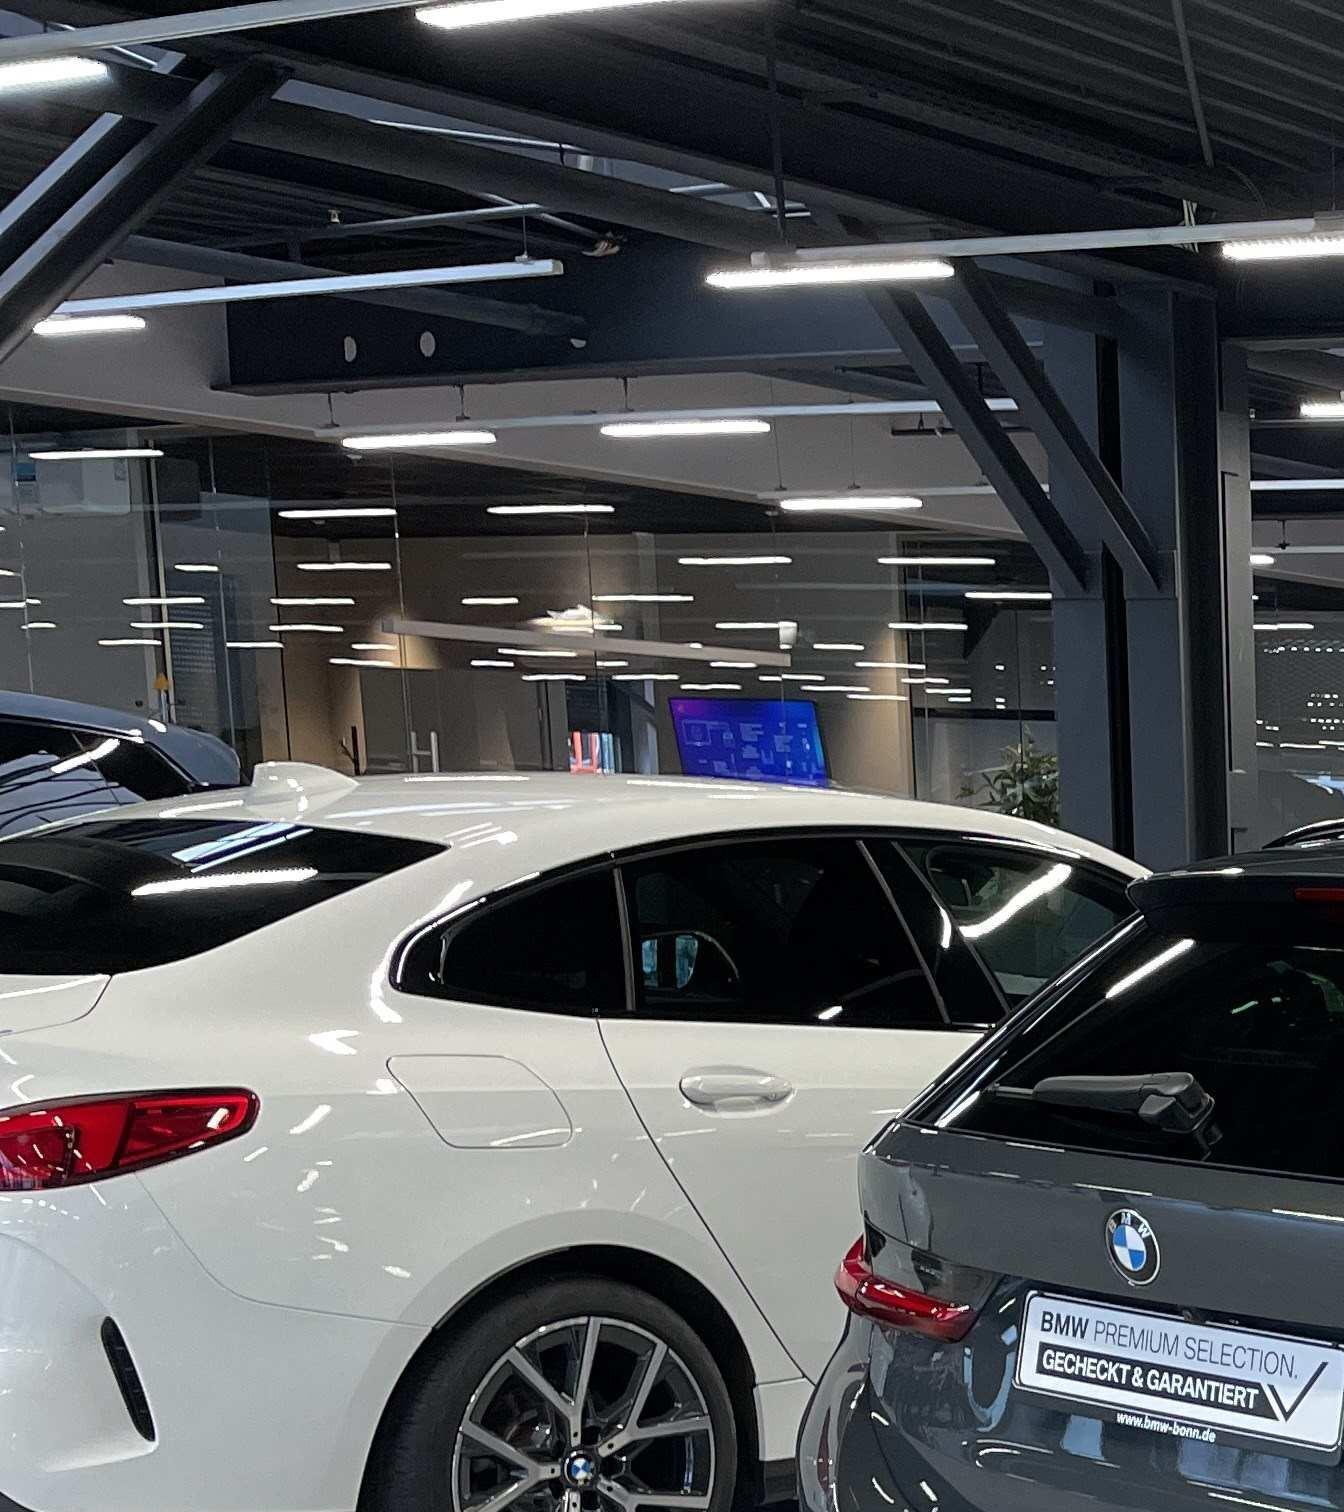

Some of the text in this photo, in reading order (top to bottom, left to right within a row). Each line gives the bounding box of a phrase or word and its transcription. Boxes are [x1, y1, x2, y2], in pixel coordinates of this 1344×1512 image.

[1108, 1211, 1152, 1239] BMW
[1040, 1310, 1089, 1340] BMW
[1093, 1320, 1180, 1358] PREMIUM
[1042, 1348, 1260, 1410] GECHECKT & GARANTIERT
[1116, 1411, 1217, 1444] www.bmw-bonn.de
